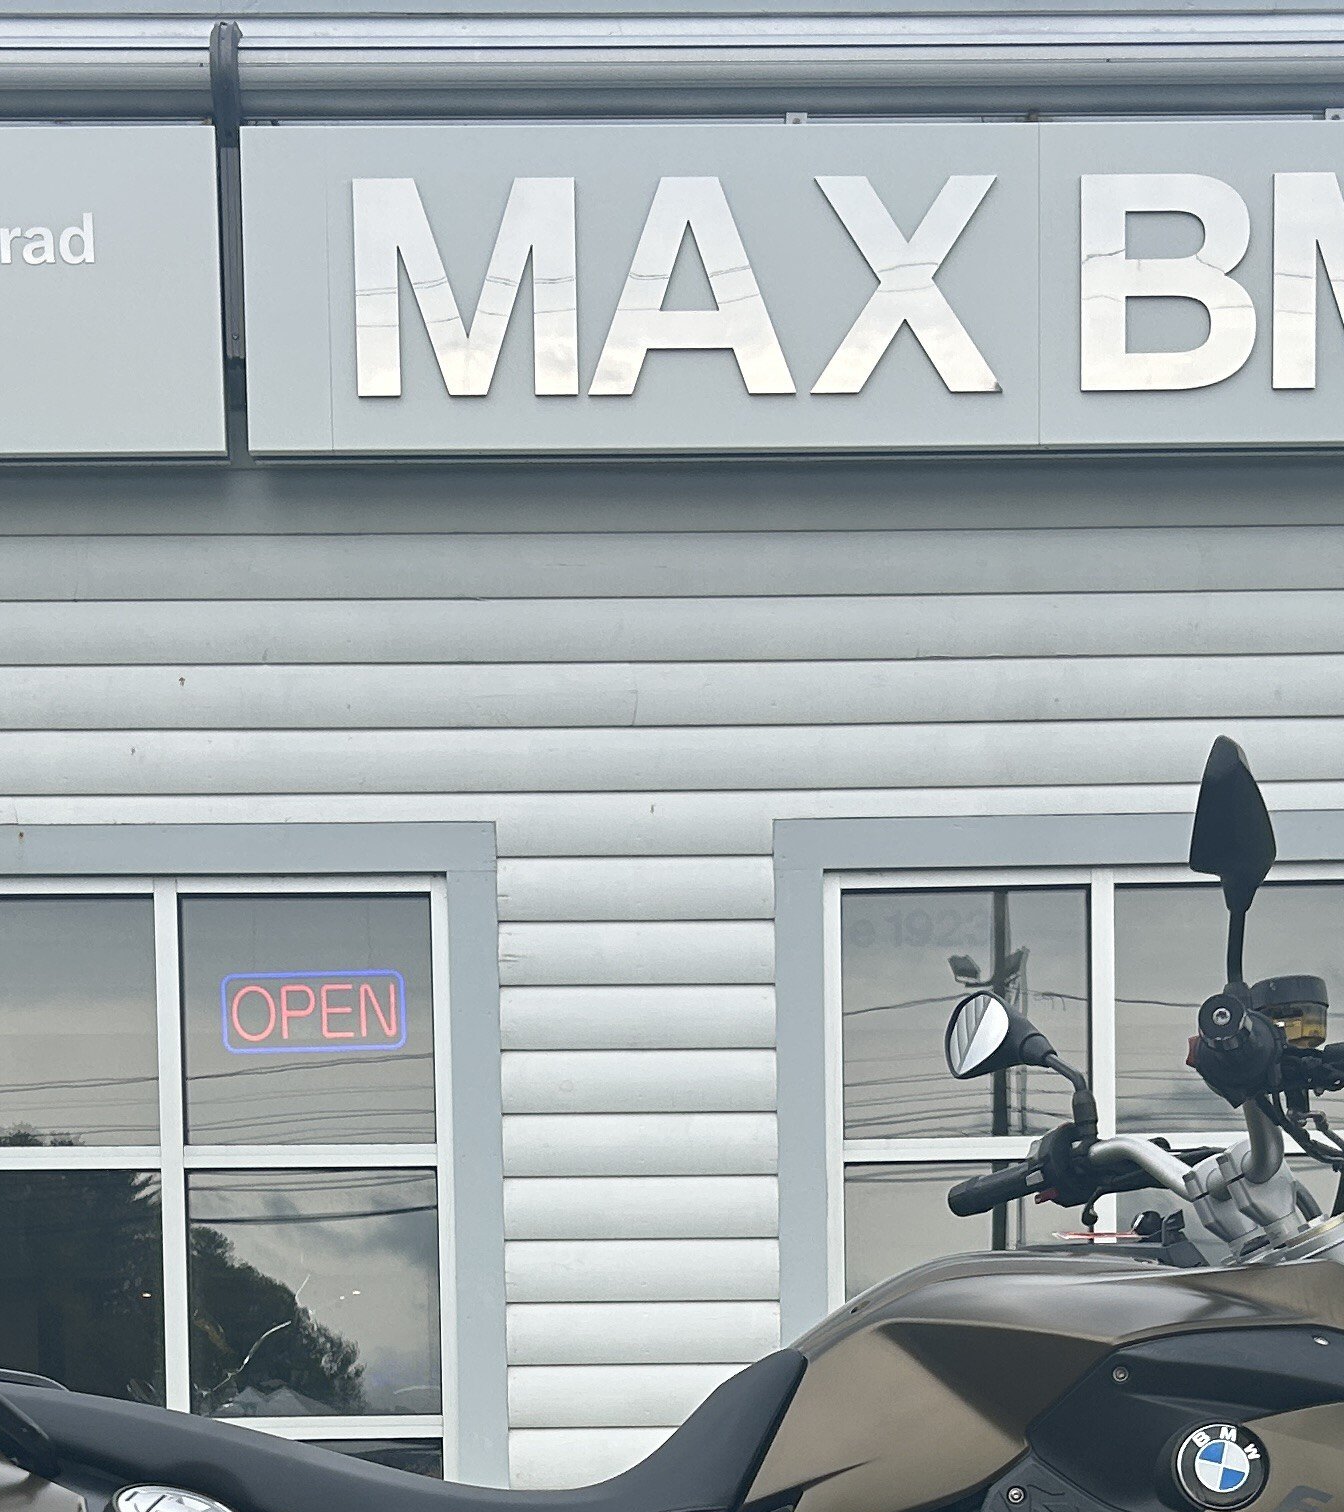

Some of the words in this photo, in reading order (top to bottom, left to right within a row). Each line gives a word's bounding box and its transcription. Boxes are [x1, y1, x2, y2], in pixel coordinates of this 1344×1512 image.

[352, 175, 1003, 398] MAX
[231, 982, 398, 1042] OPEN
[1191, 1426, 1261, 1460] BMW
